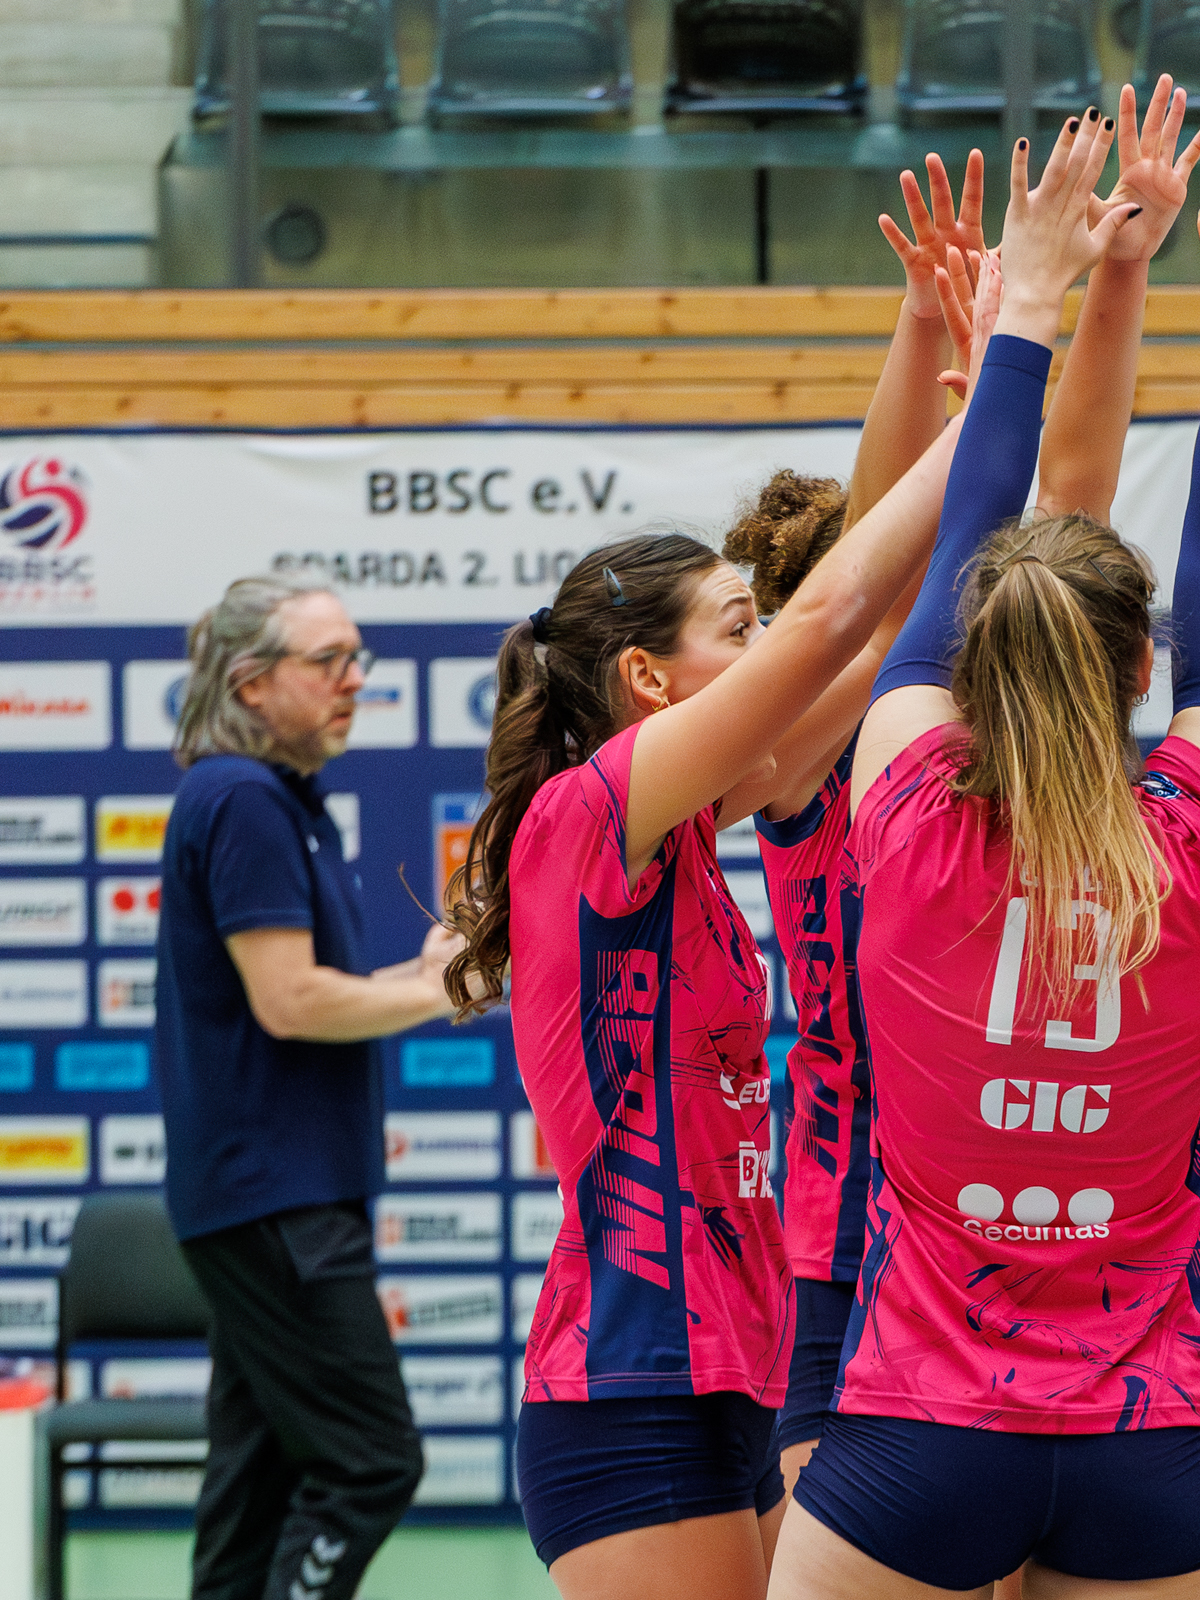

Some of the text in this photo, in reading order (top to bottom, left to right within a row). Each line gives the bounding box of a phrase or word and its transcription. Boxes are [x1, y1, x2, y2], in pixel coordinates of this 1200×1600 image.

[368, 468, 633, 515] BBSC e.V.
[986, 897, 1121, 1053] 13
[979, 1077, 1112, 1135] GIG
[963, 1218, 1111, 1242] Securitas
